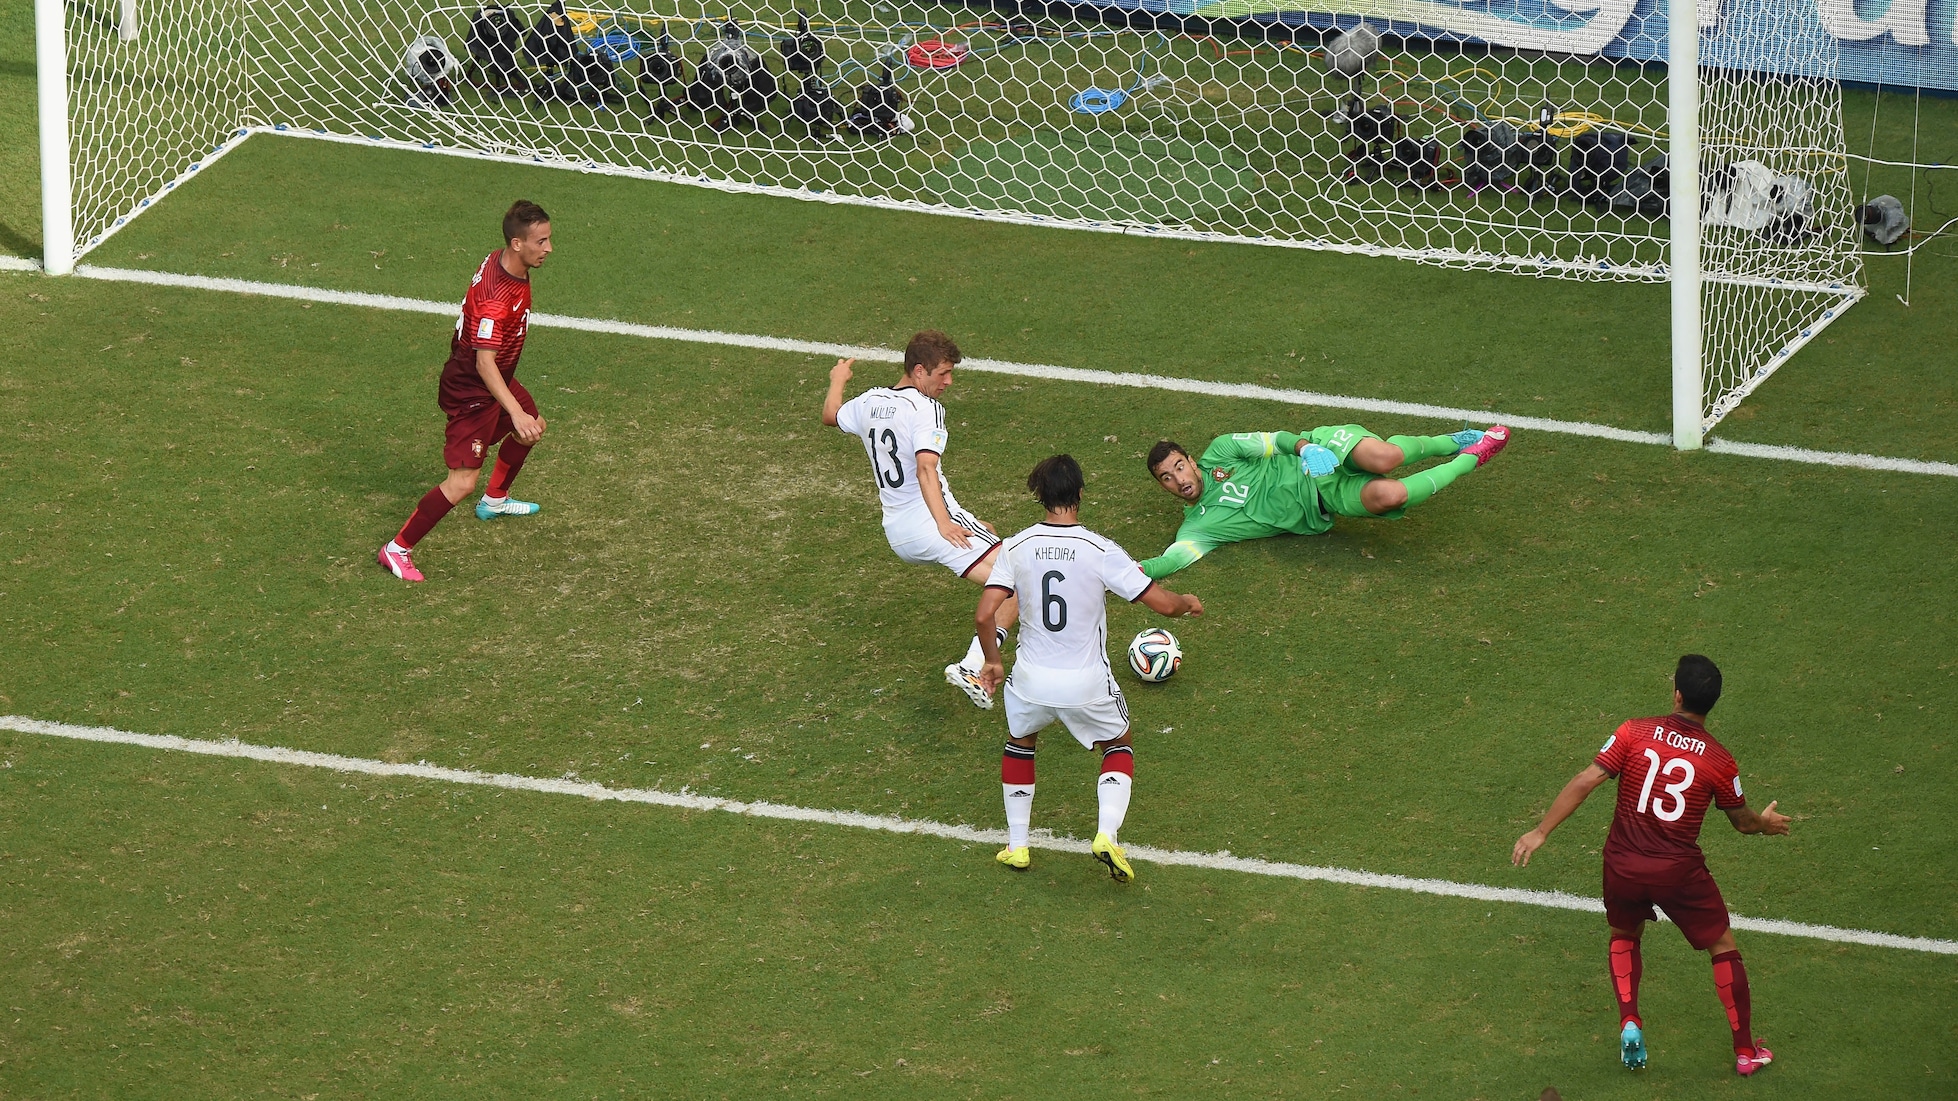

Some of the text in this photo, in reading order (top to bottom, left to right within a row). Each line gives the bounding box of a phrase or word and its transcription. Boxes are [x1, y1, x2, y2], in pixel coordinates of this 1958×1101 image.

[868, 427, 905, 489] 13
[1219, 481, 1249, 504] 12
[1034, 546, 1076, 562] KHEDIRA
[1041, 569, 1068, 633] 6
[1652, 725, 1706, 756] R. COSTA
[1637, 748, 1695, 821] 13
